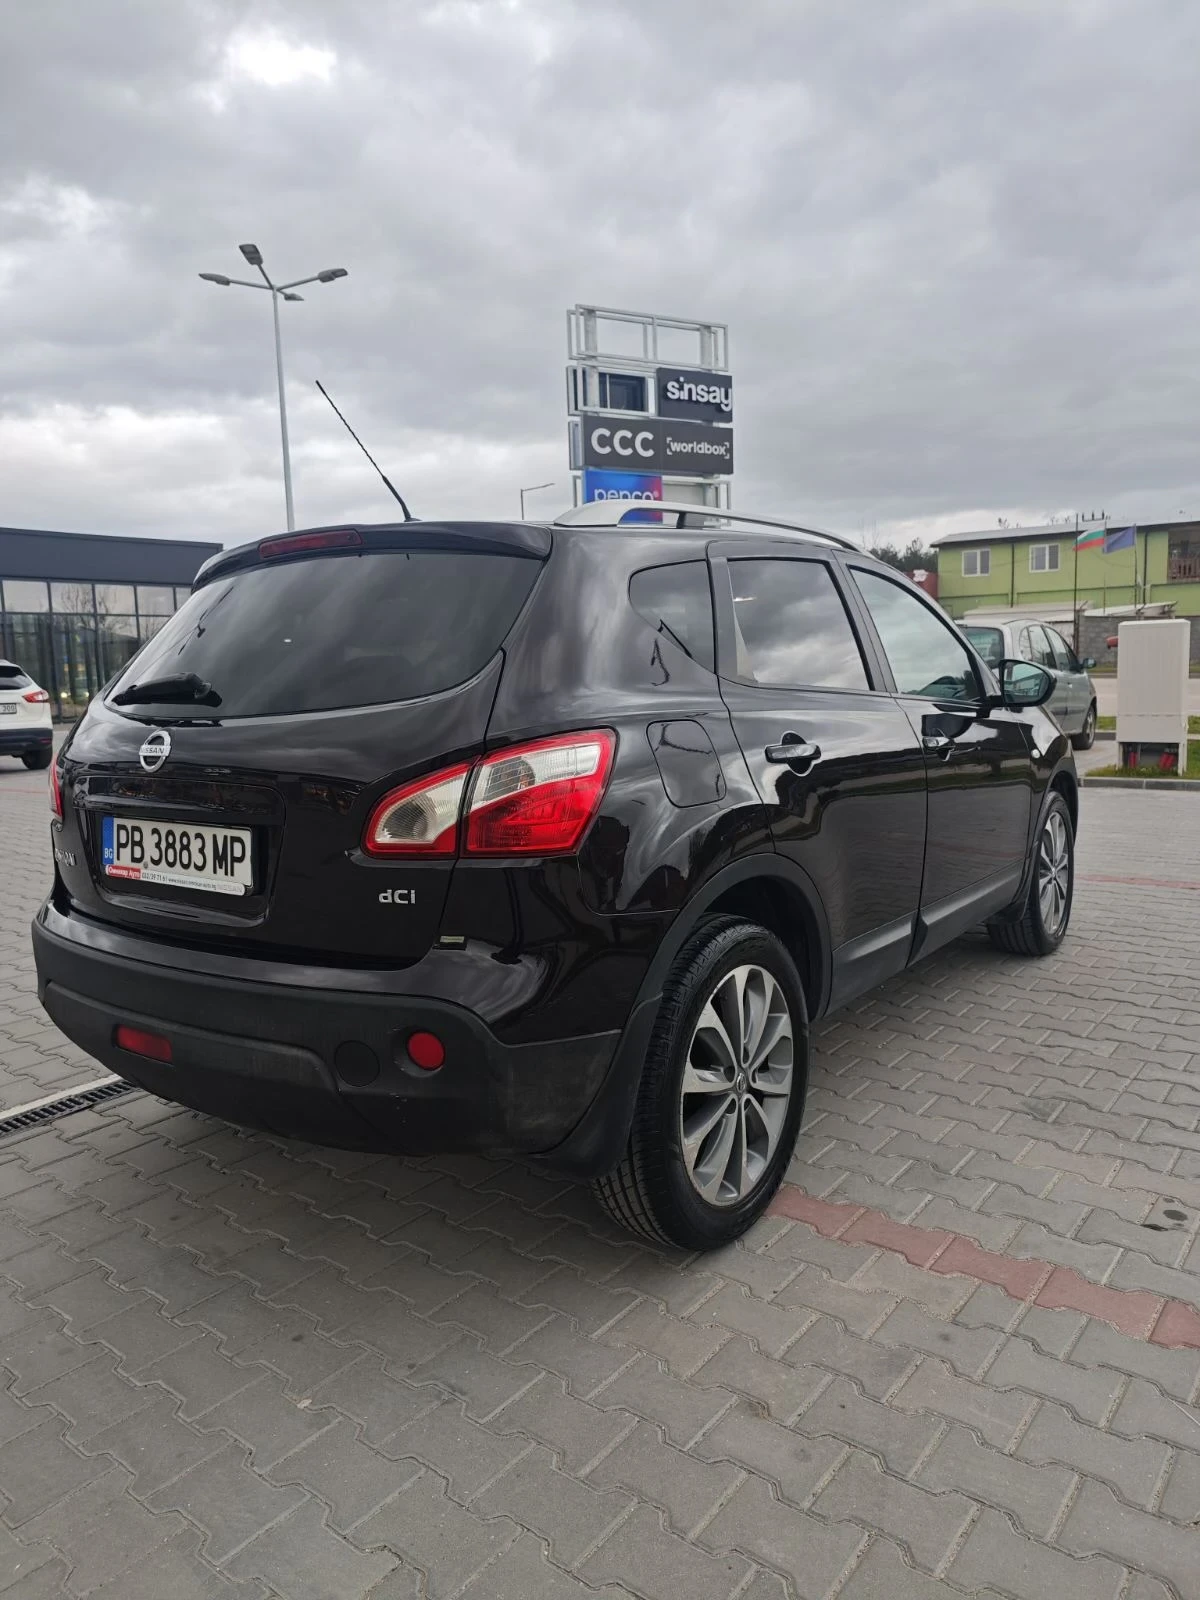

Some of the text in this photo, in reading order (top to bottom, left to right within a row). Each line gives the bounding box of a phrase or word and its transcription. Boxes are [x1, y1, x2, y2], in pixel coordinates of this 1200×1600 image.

[667, 377, 732, 411] sinsay
[591, 428, 654, 457] CCC
[104, 847, 113, 859] BG
[116, 824, 145, 864] PB
[150, 827, 206, 871] 3883
[212, 834, 246, 877] MP
[378, 889, 416, 904] dCi
